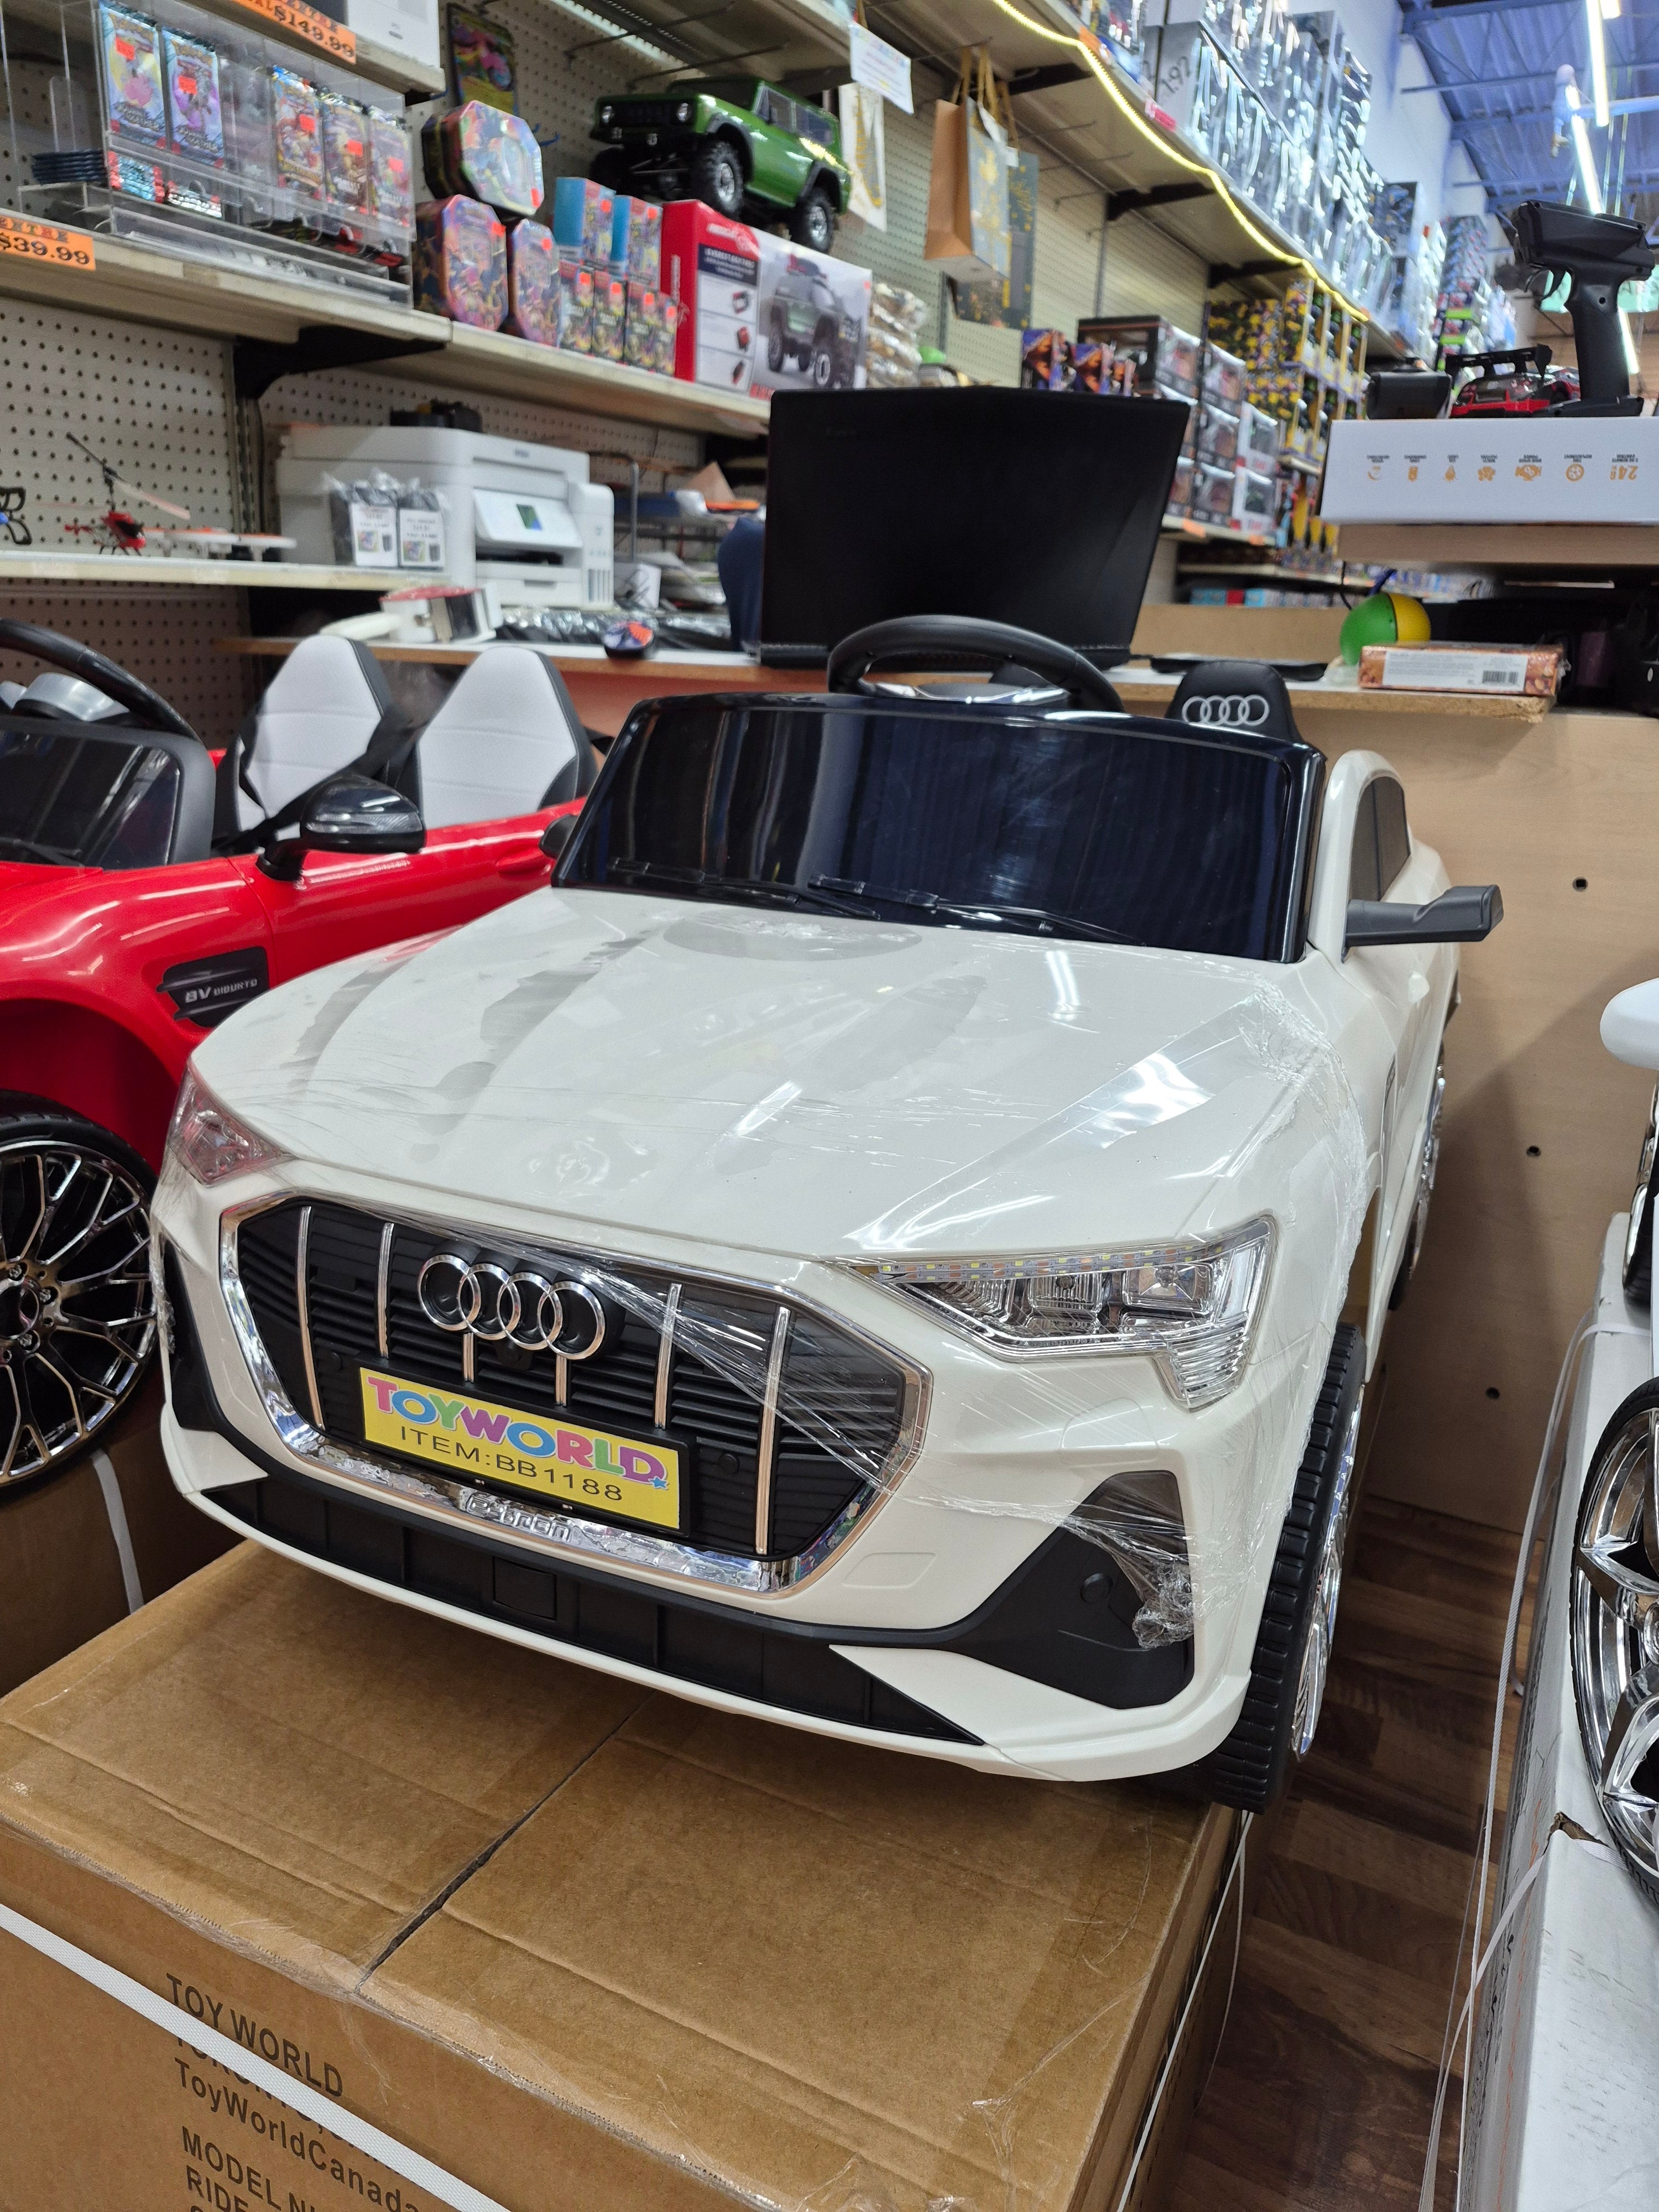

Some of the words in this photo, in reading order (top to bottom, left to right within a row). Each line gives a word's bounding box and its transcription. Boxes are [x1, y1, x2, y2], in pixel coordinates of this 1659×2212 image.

[0, 232, 90, 265] $39.99
[367, 1376, 667, 1486] TOYWORLD
[401, 1426, 623, 1502] ITEM:BB1188
[166, 1973, 223, 2028] TOY
[230, 2008, 343, 2097] WORLD
[182, 2126, 281, 2211] MODEL
